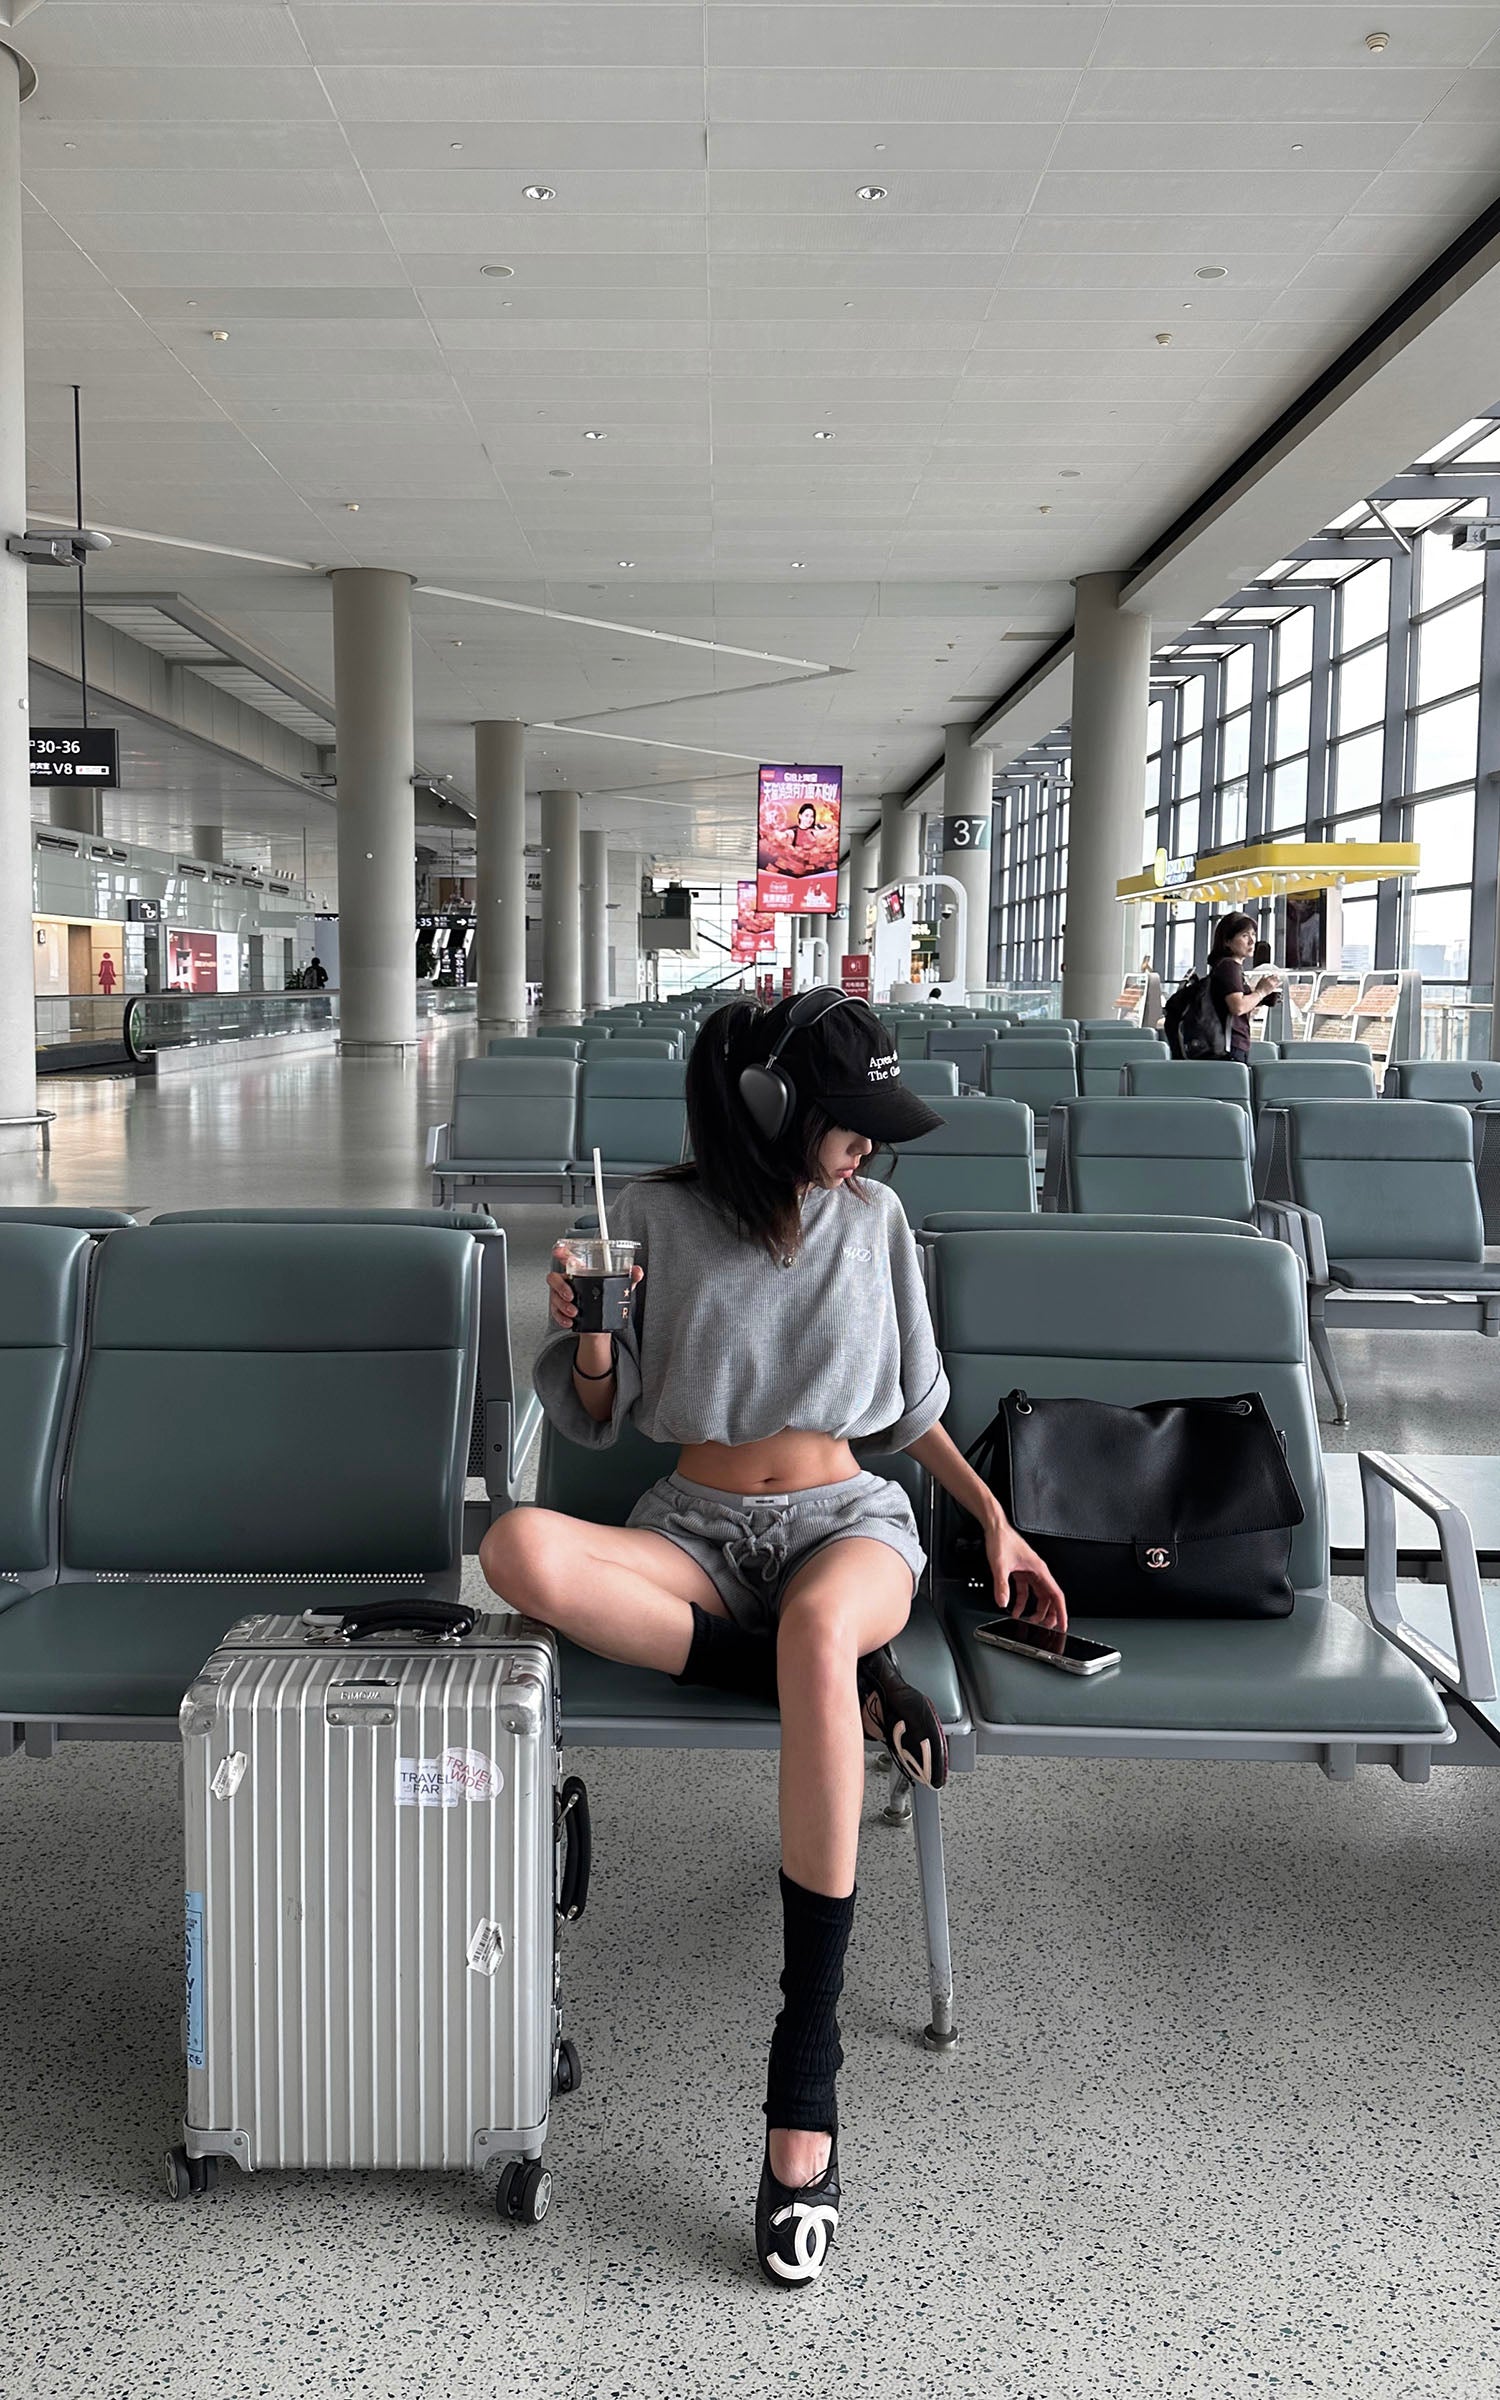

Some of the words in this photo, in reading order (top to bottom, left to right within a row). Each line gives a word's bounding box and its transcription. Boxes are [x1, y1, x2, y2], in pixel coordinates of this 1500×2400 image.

[36, 740, 80, 754] 30-36
[52, 762, 73, 775] V8
[953, 819, 987, 846] 37
[867, 1070, 889, 1082] The
[340, 1691, 382, 1700] RIMOWA
[446, 1755, 495, 1786] TRAVEL
[400, 1772, 453, 1784] TRAVEL
[451, 1769, 484, 1792] WIDE
[413, 1784, 440, 1795] FAR
